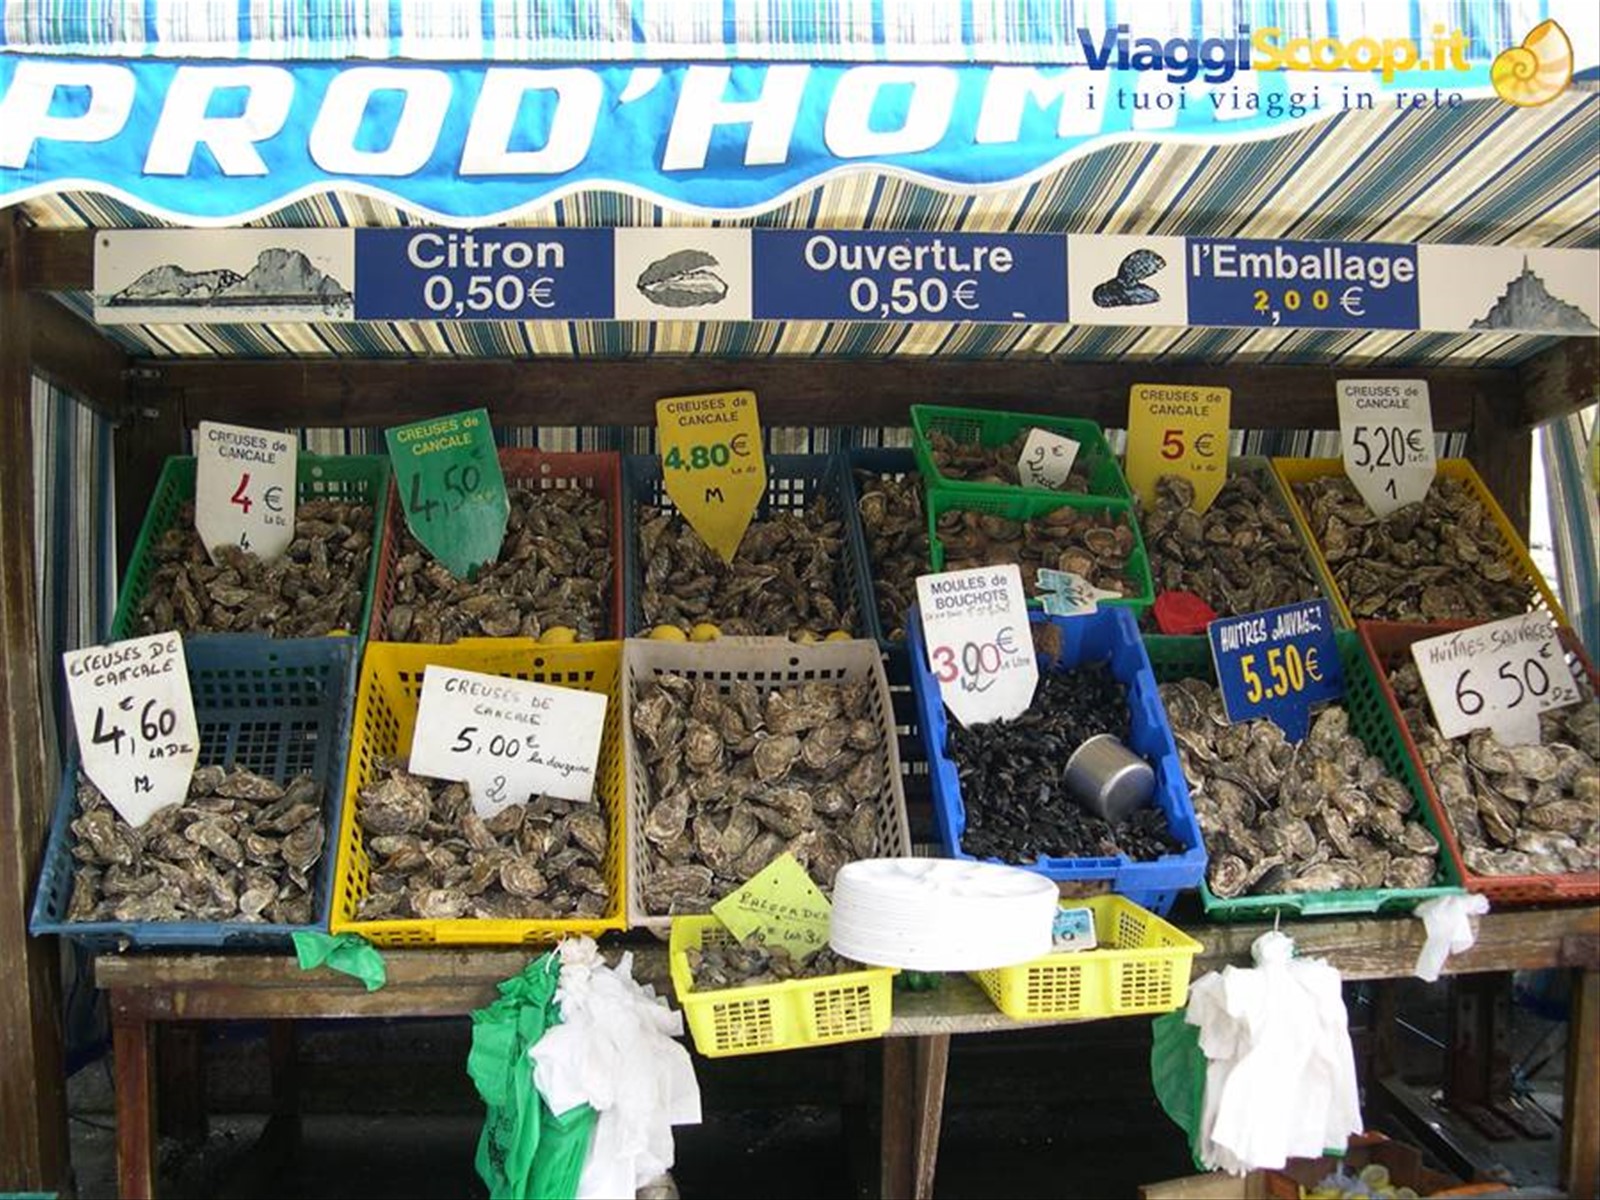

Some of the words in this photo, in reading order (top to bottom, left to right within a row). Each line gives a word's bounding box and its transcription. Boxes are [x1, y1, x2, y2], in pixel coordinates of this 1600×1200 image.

[407, 233, 565, 269] Citron
[804, 235, 1014, 273] Ouverture
[1192, 244, 1416, 289] l'Emballage
[423, 275, 556, 318] 0,50€
[850, 277, 980, 319] 0,50€
[1141, 389, 1199, 403] CREUSES
[1206, 392, 1222, 403] de
[1345, 386, 1400, 397] CREUSES
[1404, 386, 1419, 397] de
[666, 398, 727, 415] CREUSES
[732, 398, 748, 409] de
[1149, 404, 1210, 417] CANCALE
[1356, 399, 1410, 410] CANCALE
[678, 411, 739, 428] CANCALE
[208, 429, 268, 450] CREUSES
[396, 419, 460, 443] CREUSES
[218, 446, 277, 465] CANCALE
[1161, 430, 1186, 461] 5
[230, 472, 253, 514] 4
[705, 486, 725, 504] M
[930, 576, 987, 596] MOULES
[990, 573, 1008, 587] de
[935, 588, 1009, 610] BOUCHOTS
[149, 639, 178, 659] DE
[444, 677, 520, 704] CREUSES
[532, 695, 554, 711] DE
[485, 774, 507, 804] 2
